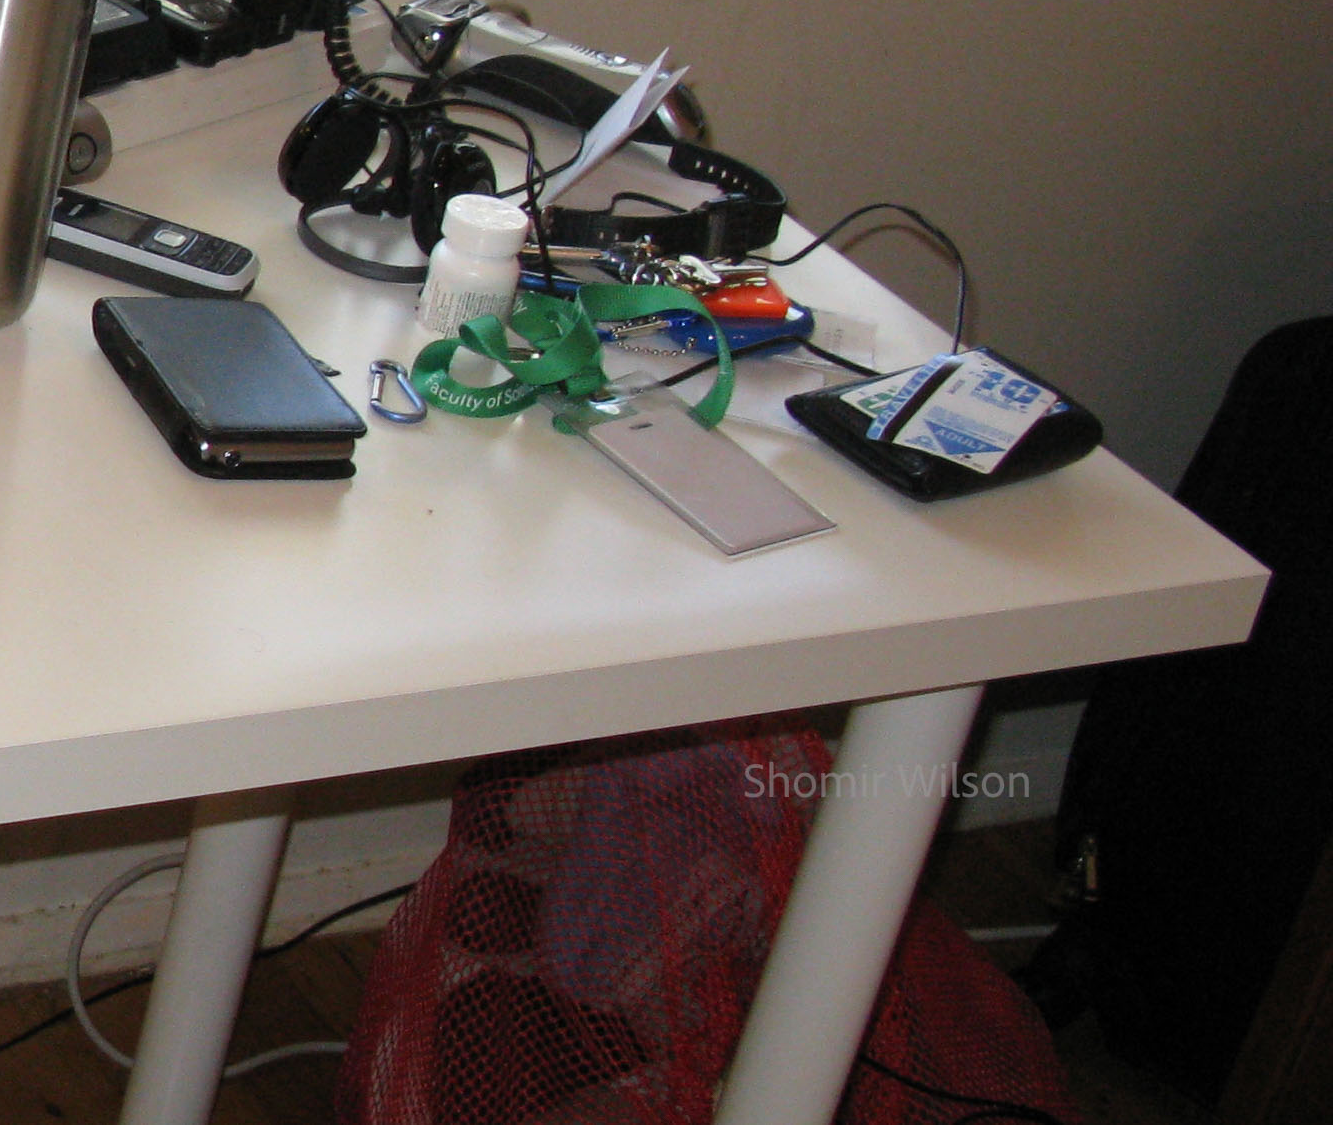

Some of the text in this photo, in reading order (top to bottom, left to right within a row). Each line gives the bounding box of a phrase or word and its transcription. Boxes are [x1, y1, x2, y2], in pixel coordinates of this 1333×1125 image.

[425, 373, 482, 412] Faculty
[486, 390, 502, 409] of
[935, 428, 987, 450] ADULT
